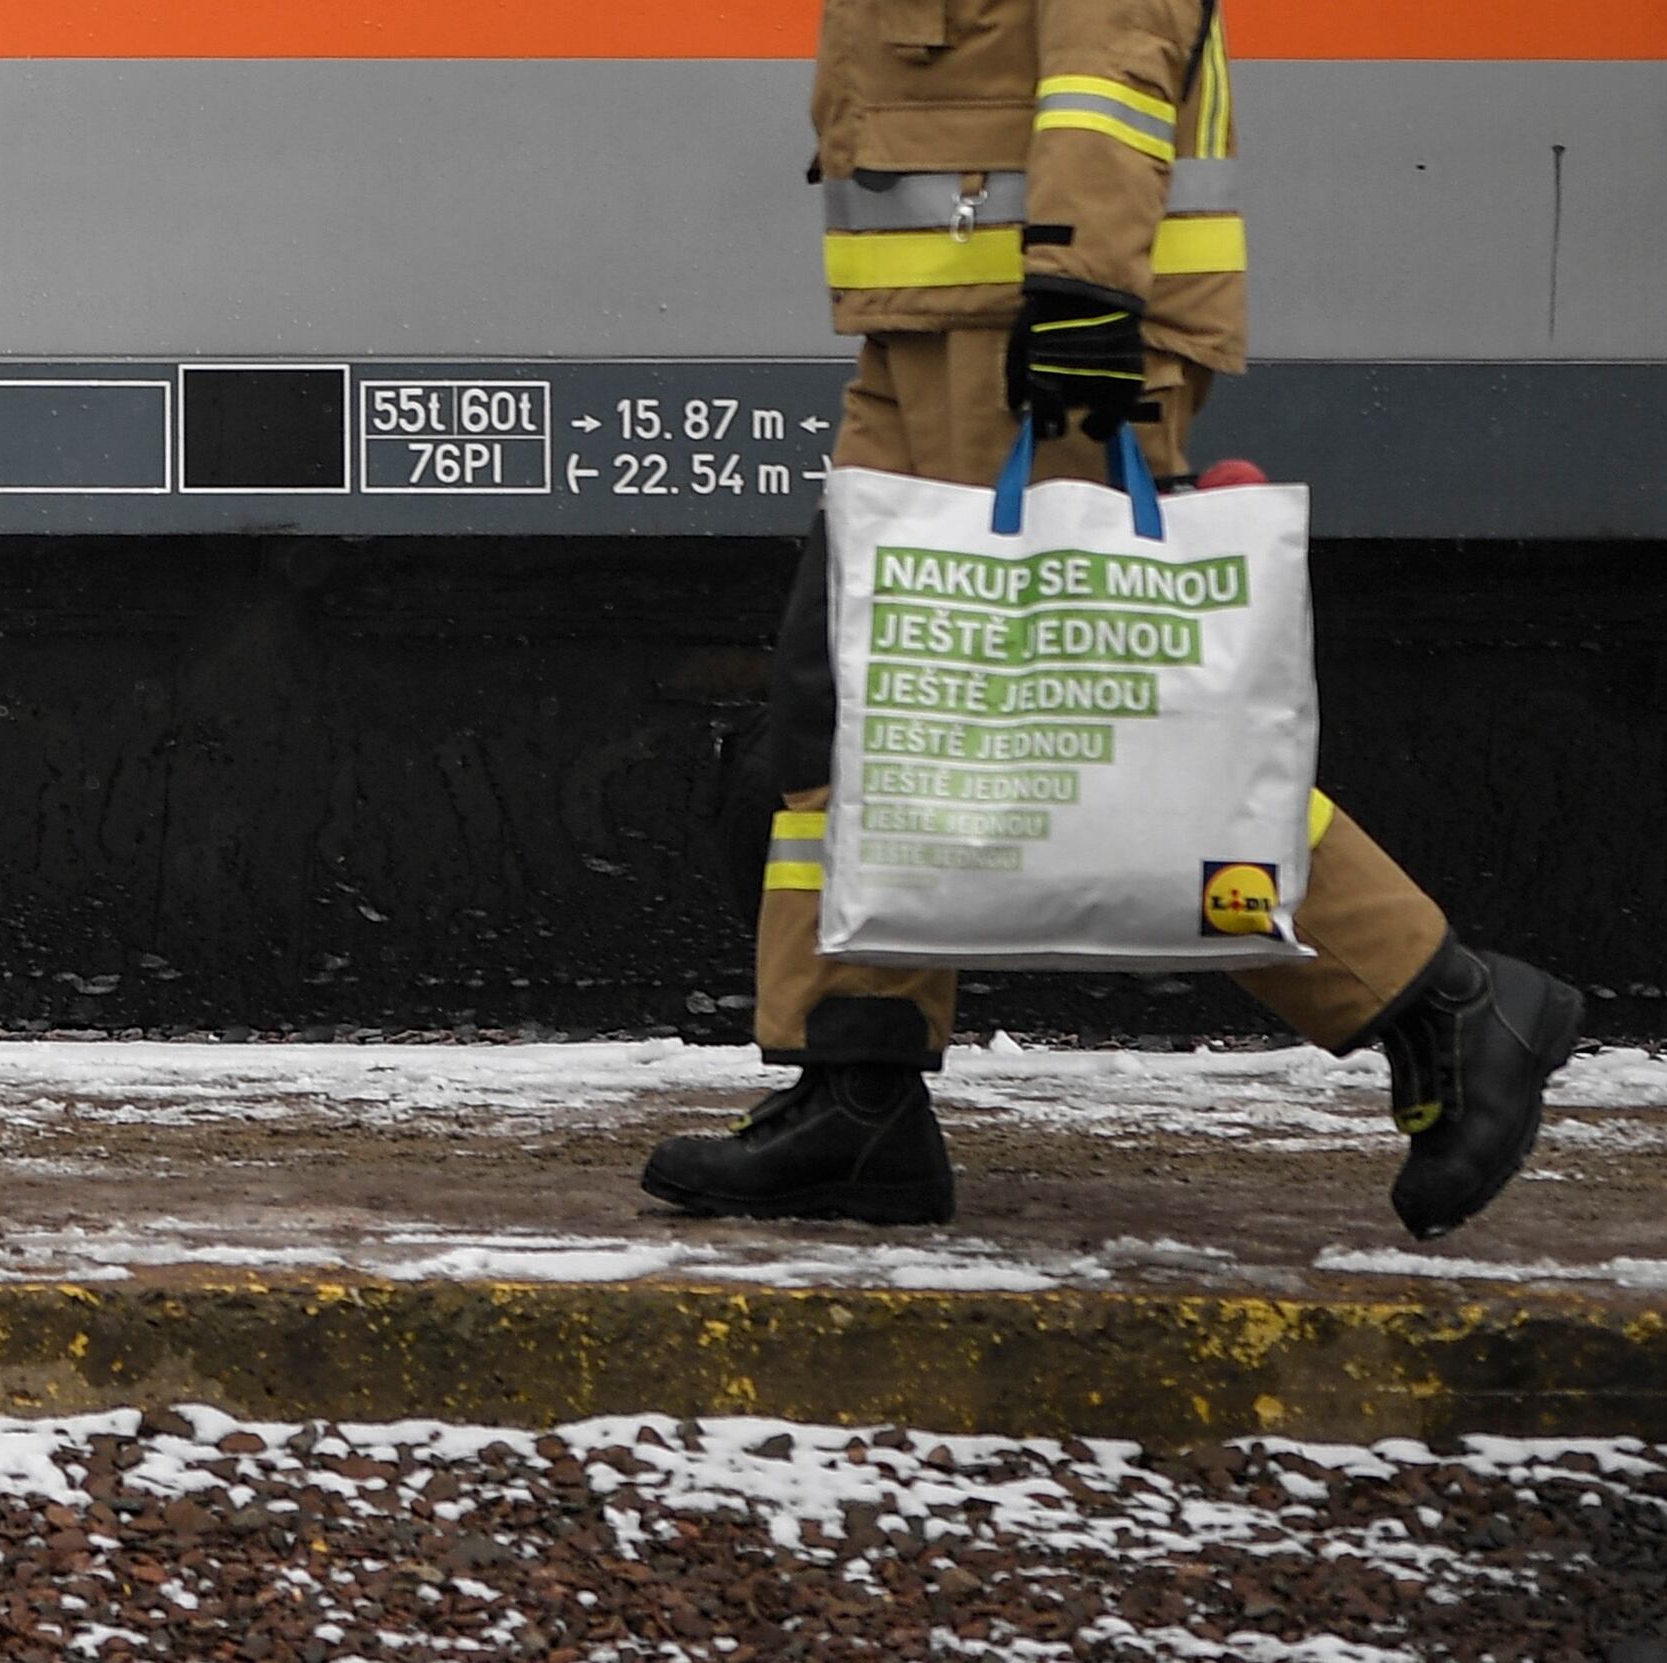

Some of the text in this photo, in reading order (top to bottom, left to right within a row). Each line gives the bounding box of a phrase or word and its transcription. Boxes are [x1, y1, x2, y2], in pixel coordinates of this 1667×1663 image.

[372, 387, 538, 433] 55t 60t
[752, 409, 785, 440] m
[758, 463, 790, 495] m
[881, 554, 1239, 607] NAKUP SE MNOU
[877, 609, 1192, 660] JEŠTĚ JEDNOU
[873, 667, 1152, 714] JEŠTĚ JEDNOU
[869, 718, 1104, 760] JEŠTĚ JEDNOU
[867, 764, 1073, 801] JEŠTĚ JEDNOU
